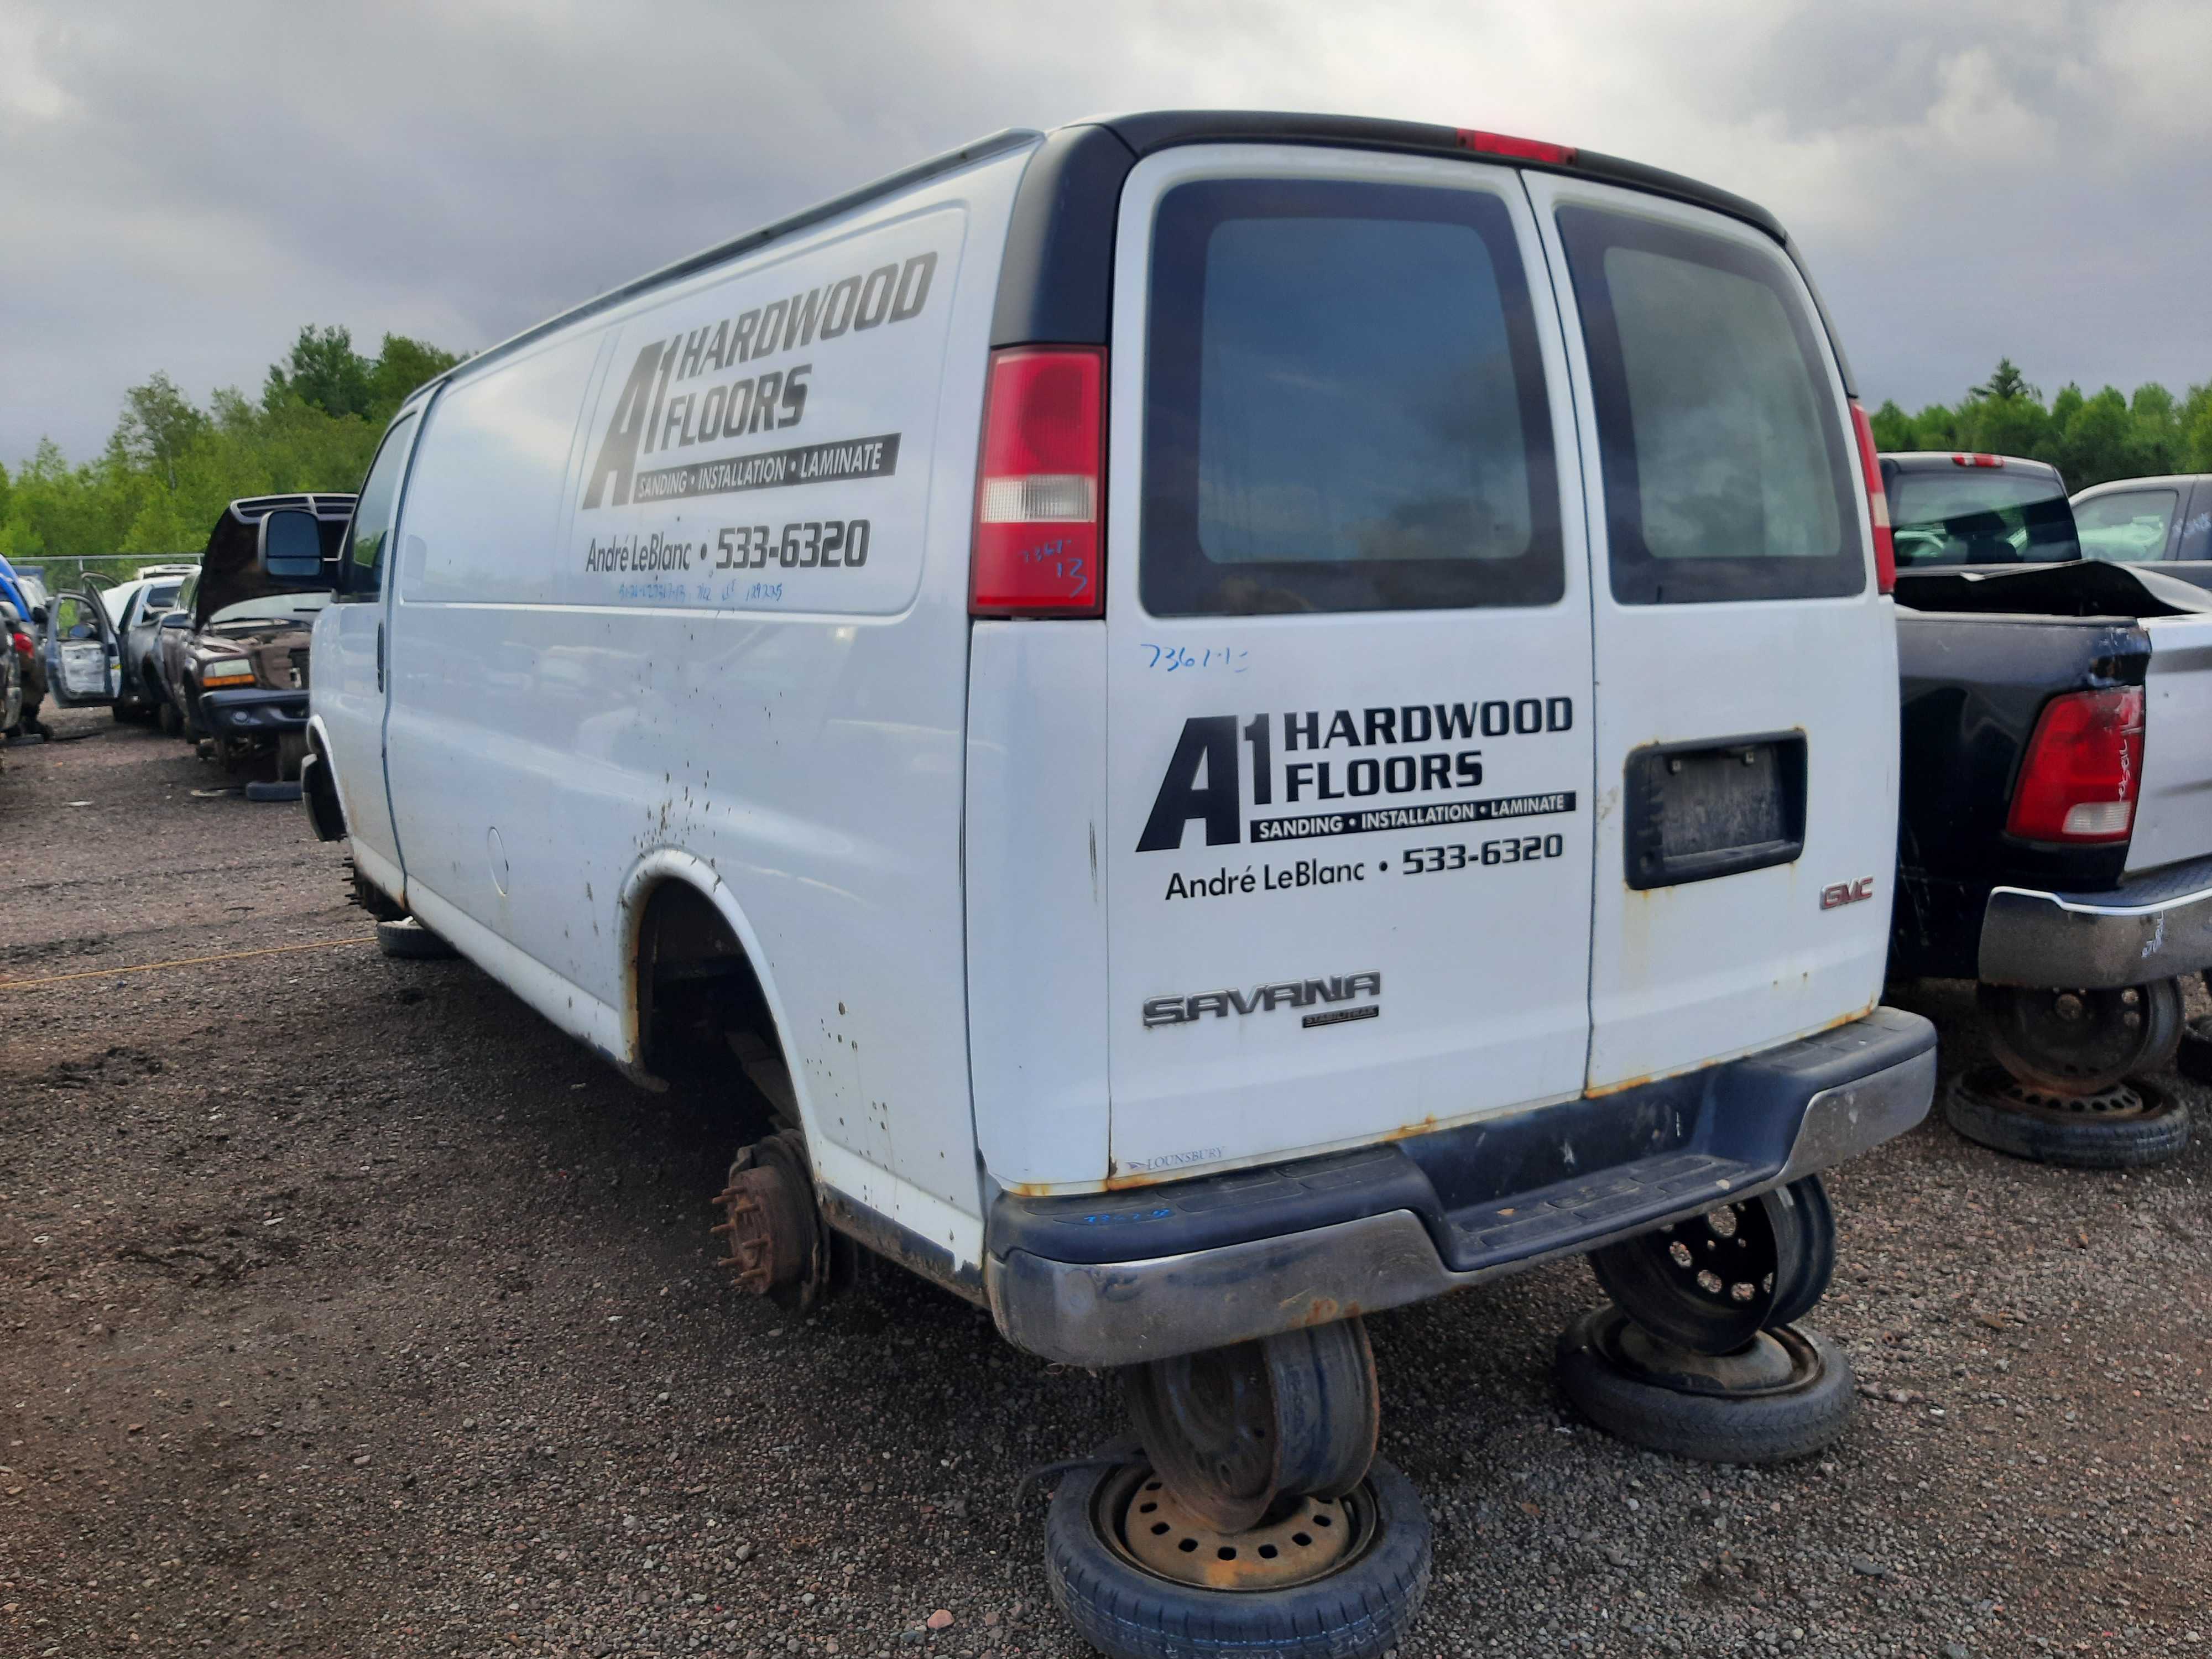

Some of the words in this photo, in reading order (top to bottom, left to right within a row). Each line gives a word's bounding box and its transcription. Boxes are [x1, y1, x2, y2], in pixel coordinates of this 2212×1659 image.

[676, 252, 937, 382] HARDWOOD
[582, 335, 682, 509] A1
[661, 364, 812, 450] FLOORS
[639, 471, 687, 497] SANDING
[698, 457, 787, 491] INSTALLATION
[800, 444, 883, 478] LAMINATE
[586, 534, 628, 572] André
[632, 533, 692, 571] LeBlanc
[716, 519, 870, 569] 533-6320
[1285, 697, 1572, 751] HARDWOOD
[1135, 713, 1271, 852] A1
[1285, 750, 1483, 802] FLOORS
[1259, 816, 1343, 839] SANDING
[1362, 804, 1474, 830] INSTALLATION
[1491, 795, 1564, 816] LAMINATE
[1165, 865, 1255, 900] André
[1264, 859, 1364, 891] LeBlanc
[1402, 834, 1563, 875] 533-6320
[1820, 875, 1874, 910] GMC
[1142, 971, 1380, 1027] SAVANA
[1147, 1146, 1222, 1170] LOUNSBURY
